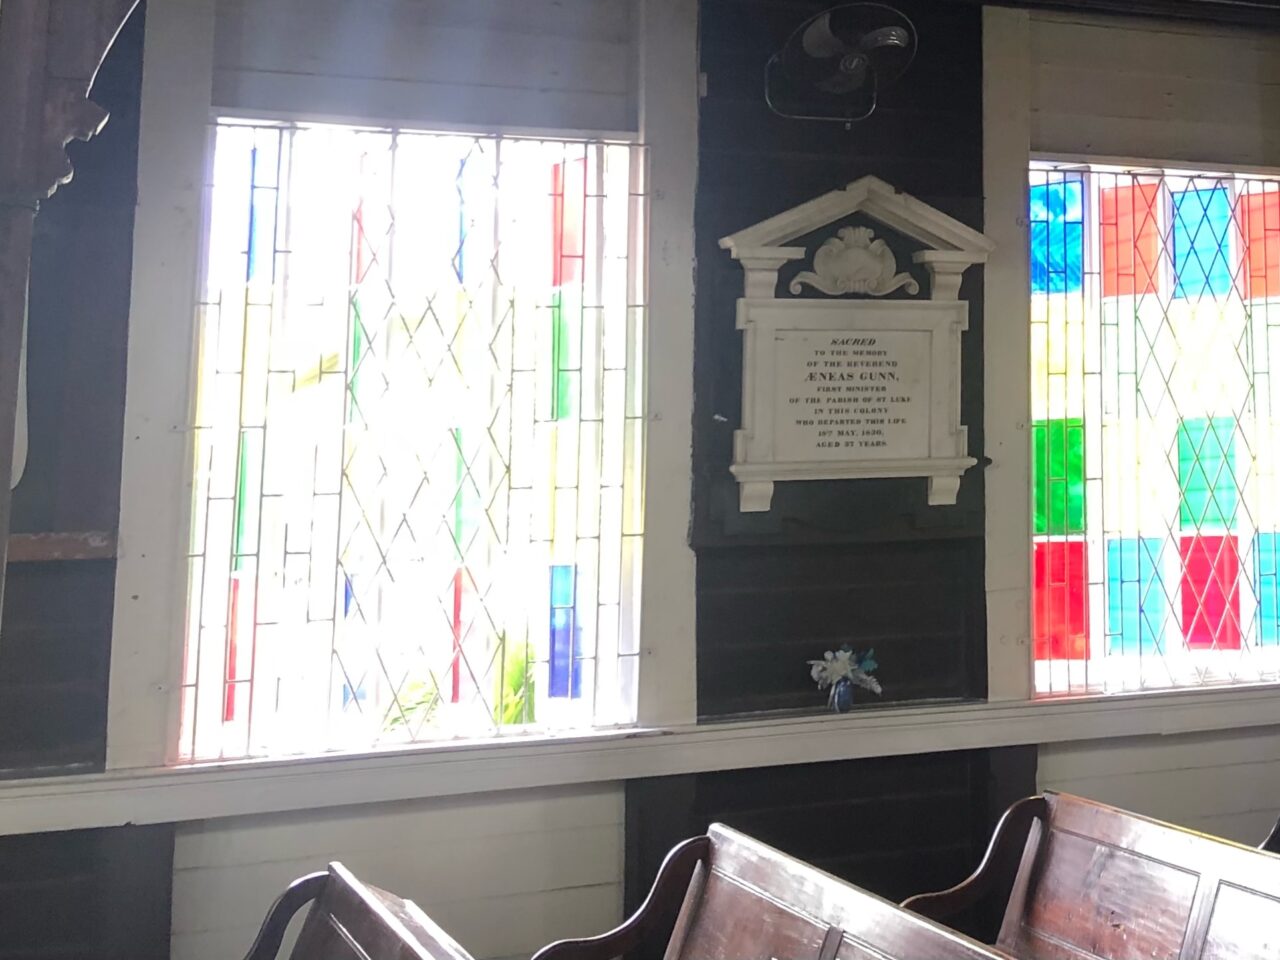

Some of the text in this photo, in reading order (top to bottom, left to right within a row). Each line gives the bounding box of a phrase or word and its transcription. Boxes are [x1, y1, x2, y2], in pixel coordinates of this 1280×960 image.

[830, 338, 876, 346] SACRED
[804, 372, 899, 382] ÆNEAS GUNN,
